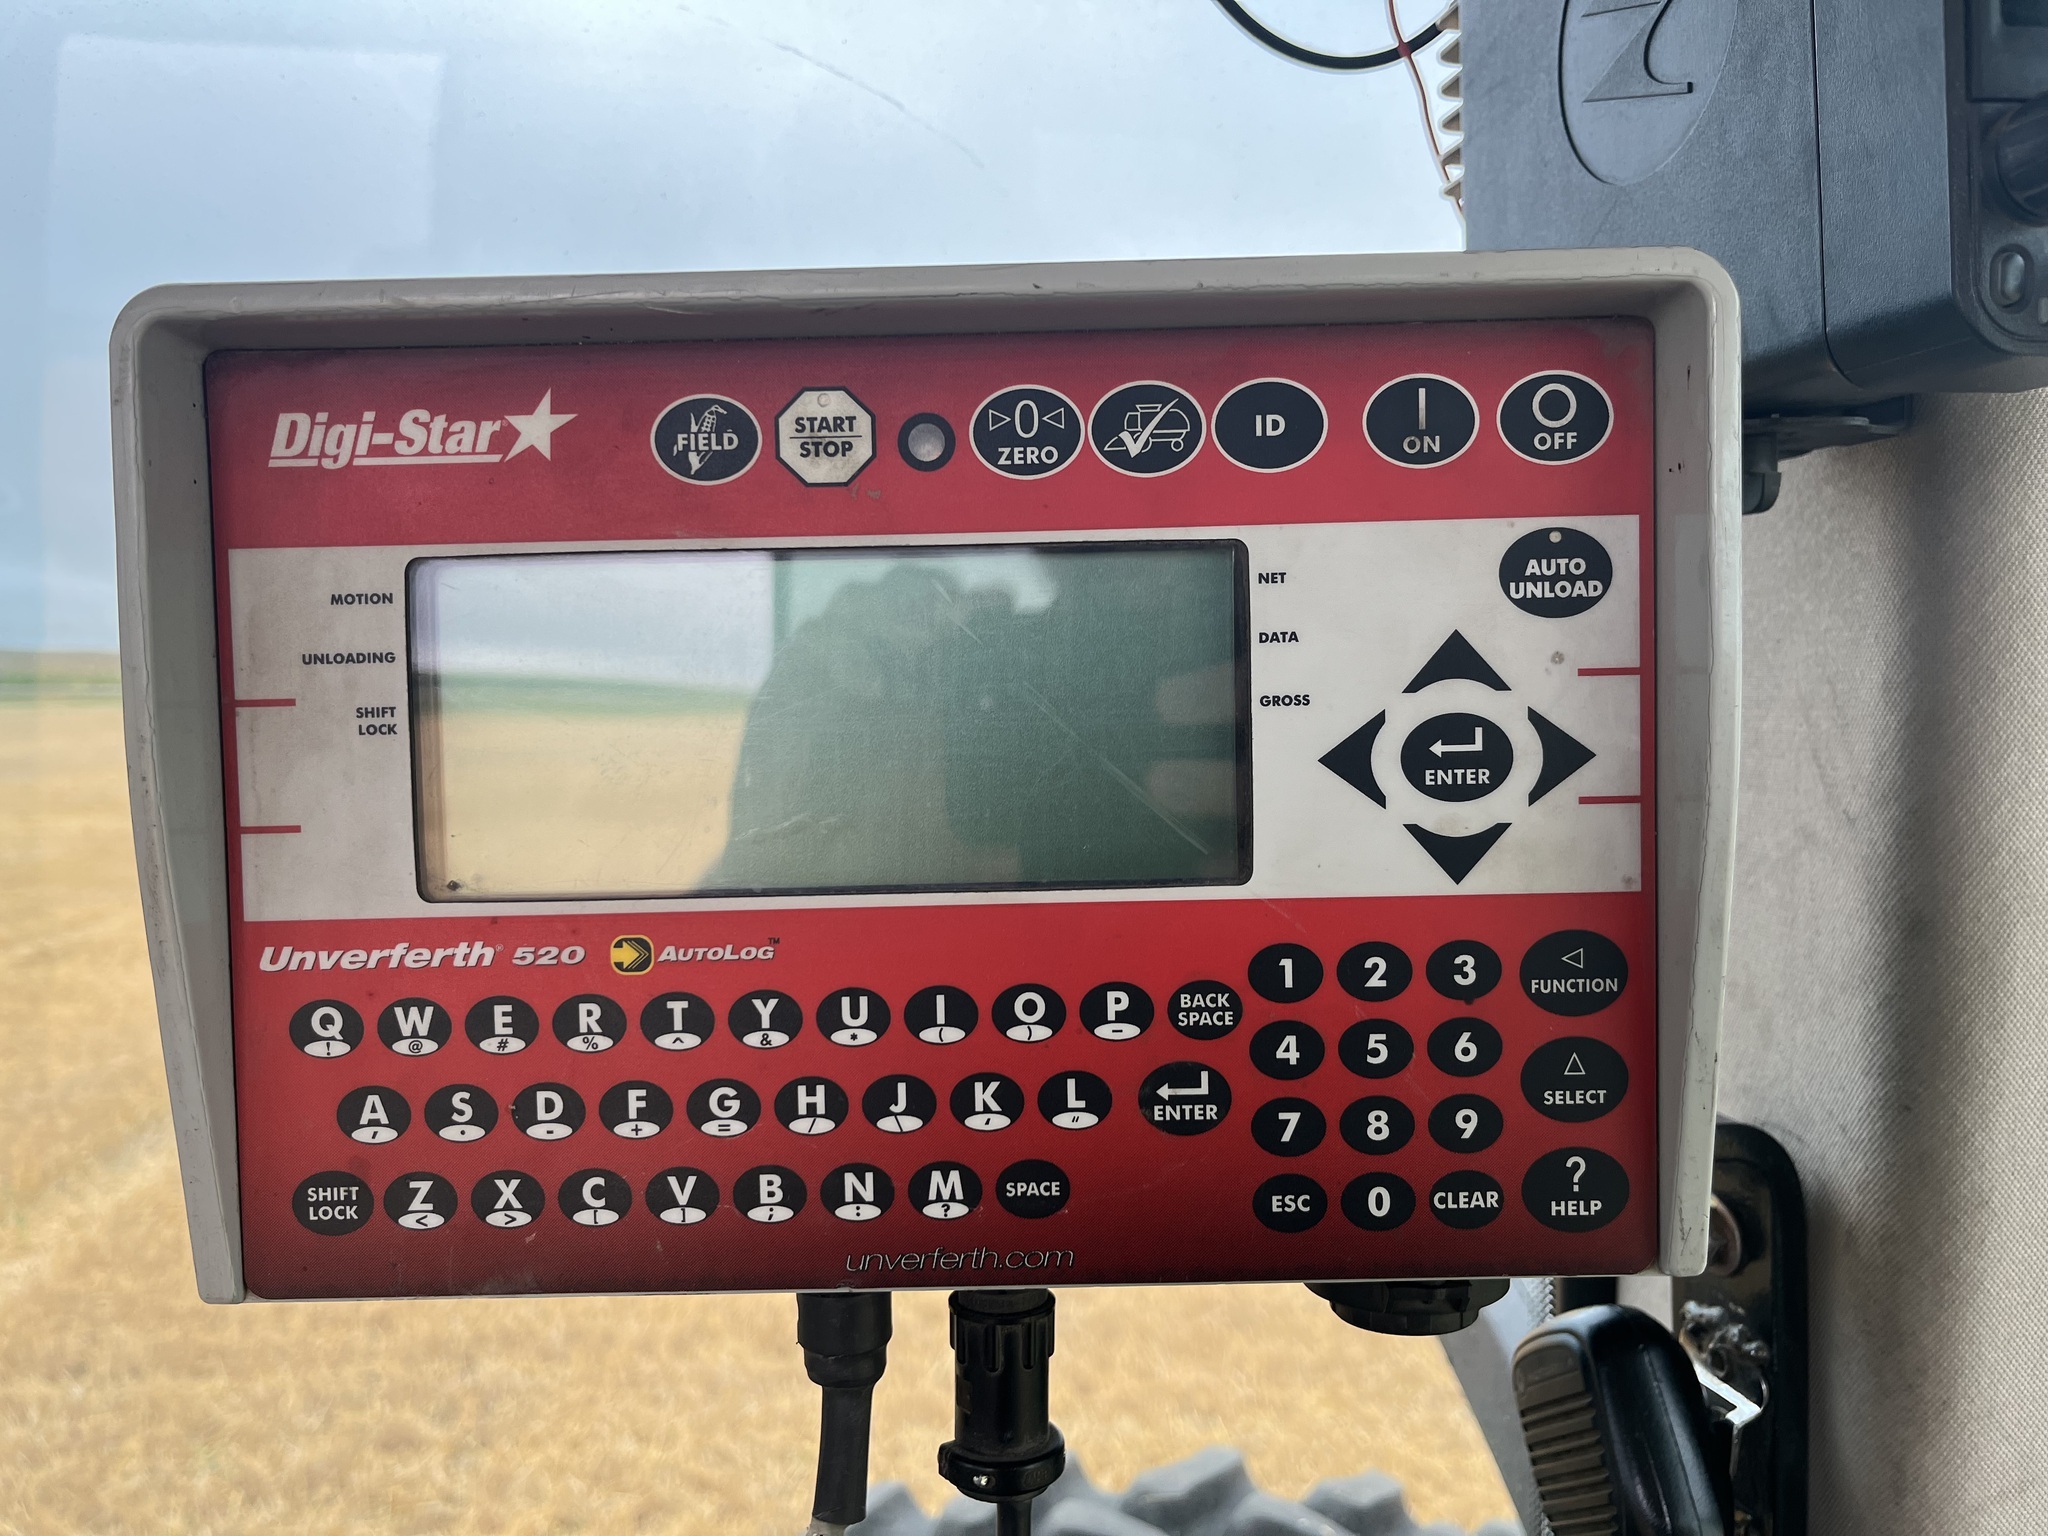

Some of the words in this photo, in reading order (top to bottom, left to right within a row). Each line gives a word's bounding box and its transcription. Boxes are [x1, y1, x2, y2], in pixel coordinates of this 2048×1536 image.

[795, 416, 856, 433] START
[1256, 415, 1285, 436] ID
[677, 432, 739, 451] FIELD
[799, 441, 853, 458] STOP
[1403, 436, 1440, 453] ON
[1534, 432, 1577, 450] OFF
[998, 446, 1058, 466] ZERO
[1259, 572, 1286, 584] NET
[1525, 558, 1586, 575] AUTO
[331, 593, 393, 605] MOTION
[1509, 581, 1603, 598] UNLOAD
[1259, 631, 1299, 643] DATA
[302, 652, 395, 665] UNLOADING
[356, 707, 396, 718] SHIFT
[1260, 695, 1310, 707] GROSS
[359, 724, 397, 735] LOCK
[1426, 769, 1489, 785] ENTER
[512, 946, 584, 965] 520
[1279, 959, 1292, 988] 1
[1365, 957, 1386, 987] 2
[1454, 955, 1476, 985] 3
[1532, 979, 1617, 993] FUNCTION
[752, 999, 778, 1029] Y
[842, 996, 868, 1027] U
[937, 995, 945, 1024] I
[1015, 992, 1045, 1023] O
[1107, 991, 1129, 1020] P
[1181, 994, 1229, 1008] BACK
[311, 1007, 343, 1039] Q
[394, 1007, 433, 1036] W
[494, 1005, 513, 1034] E
[579, 1003, 602, 1033] R
[667, 1001, 688, 1030] T
[1179, 1012, 1233, 1026] SPACE
[408, 1040, 423, 1053] @
[496, 1038, 509, 1051] #
[582, 1036, 598, 1050] %
[760, 1033, 772, 1046] &
[1276, 1036, 1299, 1065] 4
[1367, 1034, 1388, 1064] 5
[1455, 1032, 1477, 1062] 6
[452, 1092, 472, 1123] S
[537, 1091, 563, 1120] D
[628, 1090, 646, 1119] F
[709, 1087, 740, 1117] G
[798, 1085, 825, 1115] H
[890, 1083, 906, 1113] J
[975, 1082, 1001, 1111] K
[1067, 1079, 1085, 1108] L
[1544, 1090, 1606, 1105] SELECT
[360, 1095, 389, 1124] A
[1154, 1105, 1217, 1120] ENTER
[1456, 1109, 1477, 1138] 9
[1279, 1113, 1300, 1141] 7
[1367, 1110, 1389, 1140] 8
[308, 1187, 358, 1201] SHIFT
[408, 1181, 433, 1210] Z
[494, 1179, 522, 1209] X
[583, 1177, 605, 1208] C
[667, 1176, 696, 1205] V
[760, 1174, 783, 1204] B
[845, 1172, 873, 1202] N
[929, 1171, 963, 1200] M
[1006, 1182, 1060, 1197] SPACE
[310, 1206, 358, 1220] LOCK
[941, 1203, 950, 1217] ?
[1272, 1195, 1310, 1212] ESC
[1368, 1187, 1390, 1217] 0
[1434, 1191, 1498, 1209] CLEAR
[1552, 1201, 1602, 1215] HELP
[846, 1247, 1073, 1271] unverferth.com
